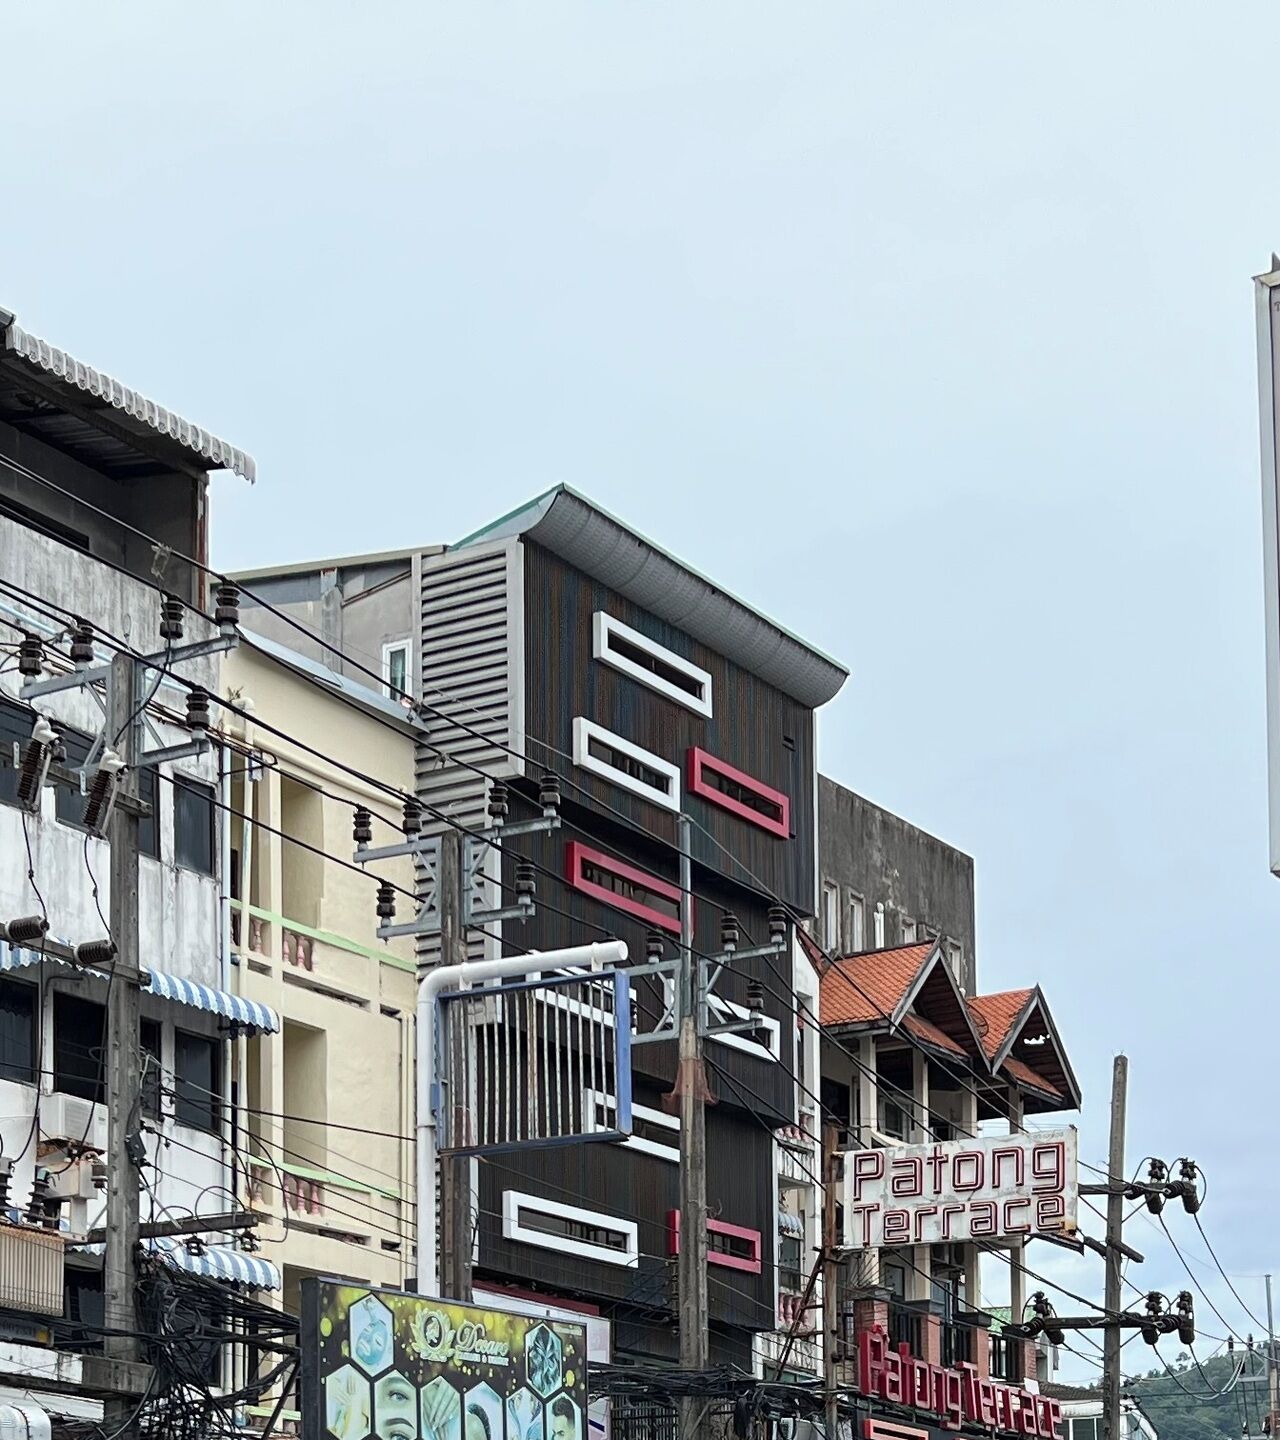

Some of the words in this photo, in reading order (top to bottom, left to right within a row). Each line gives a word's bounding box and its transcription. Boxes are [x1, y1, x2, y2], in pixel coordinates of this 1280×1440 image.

[853, 1141, 1065, 1201] Patong
[852, 1194, 1065, 1248] Terrace
[858, 1325, 965, 1431] Patong
